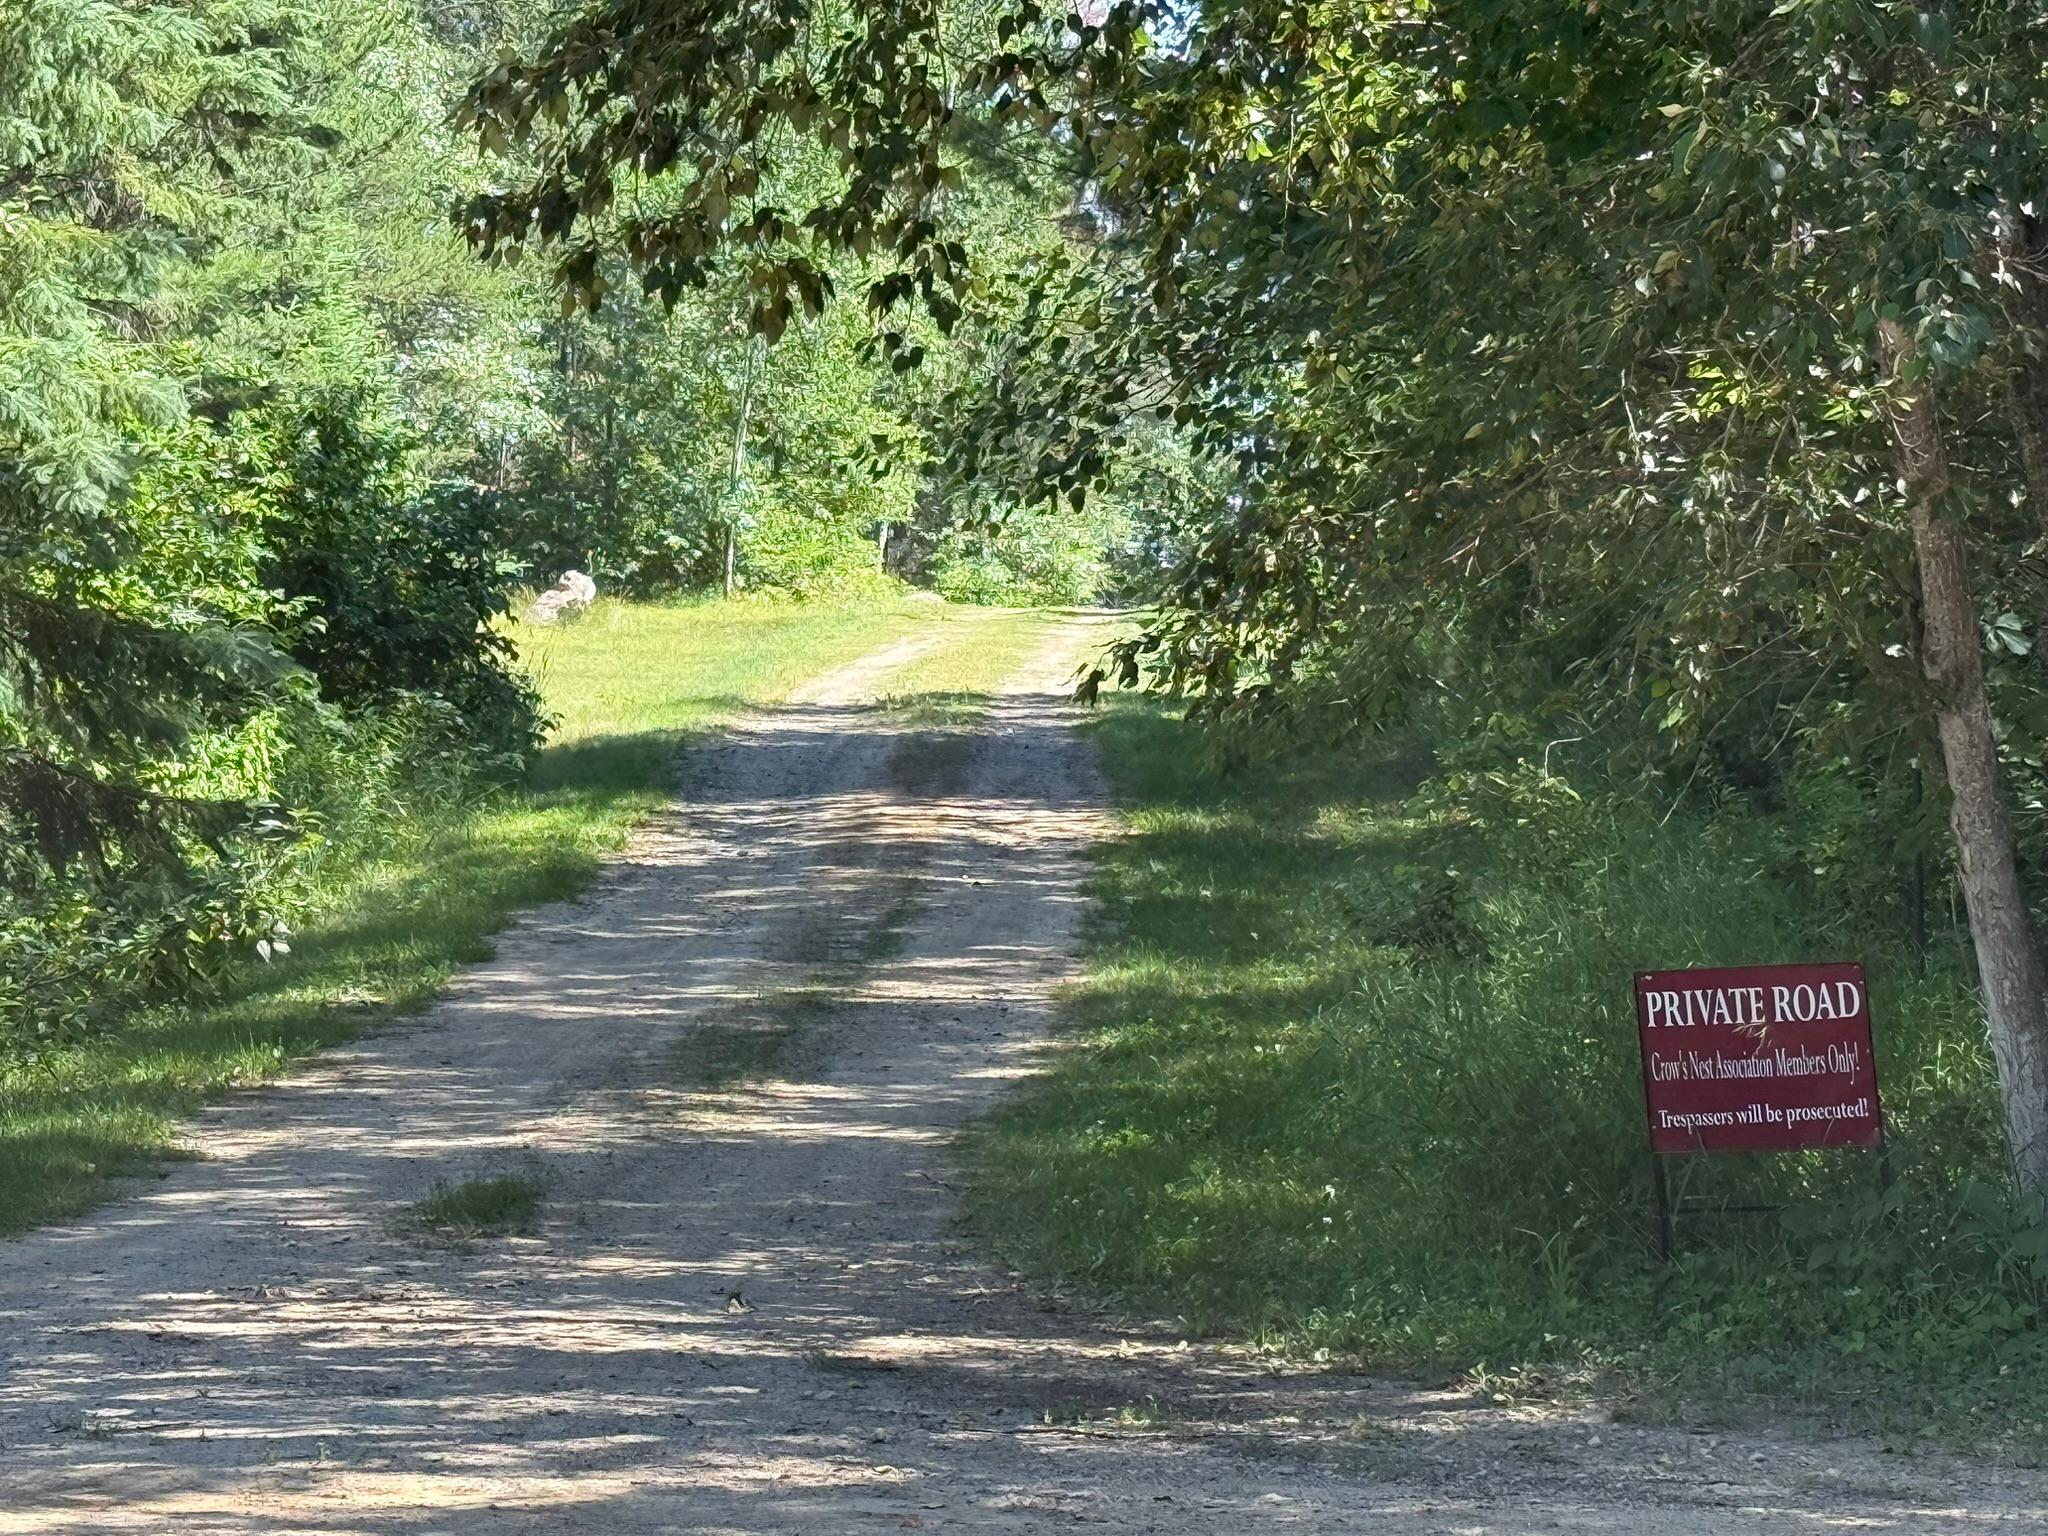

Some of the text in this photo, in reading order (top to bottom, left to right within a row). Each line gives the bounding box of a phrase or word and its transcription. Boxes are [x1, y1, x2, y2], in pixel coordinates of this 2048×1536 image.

[1645, 981, 1860, 1027] PRIVATE ROAD
[1651, 1041, 1860, 1085] Crow's Nest Association Members Only!
[1658, 1098, 1869, 1135] Trespassers will be prosecuted!
